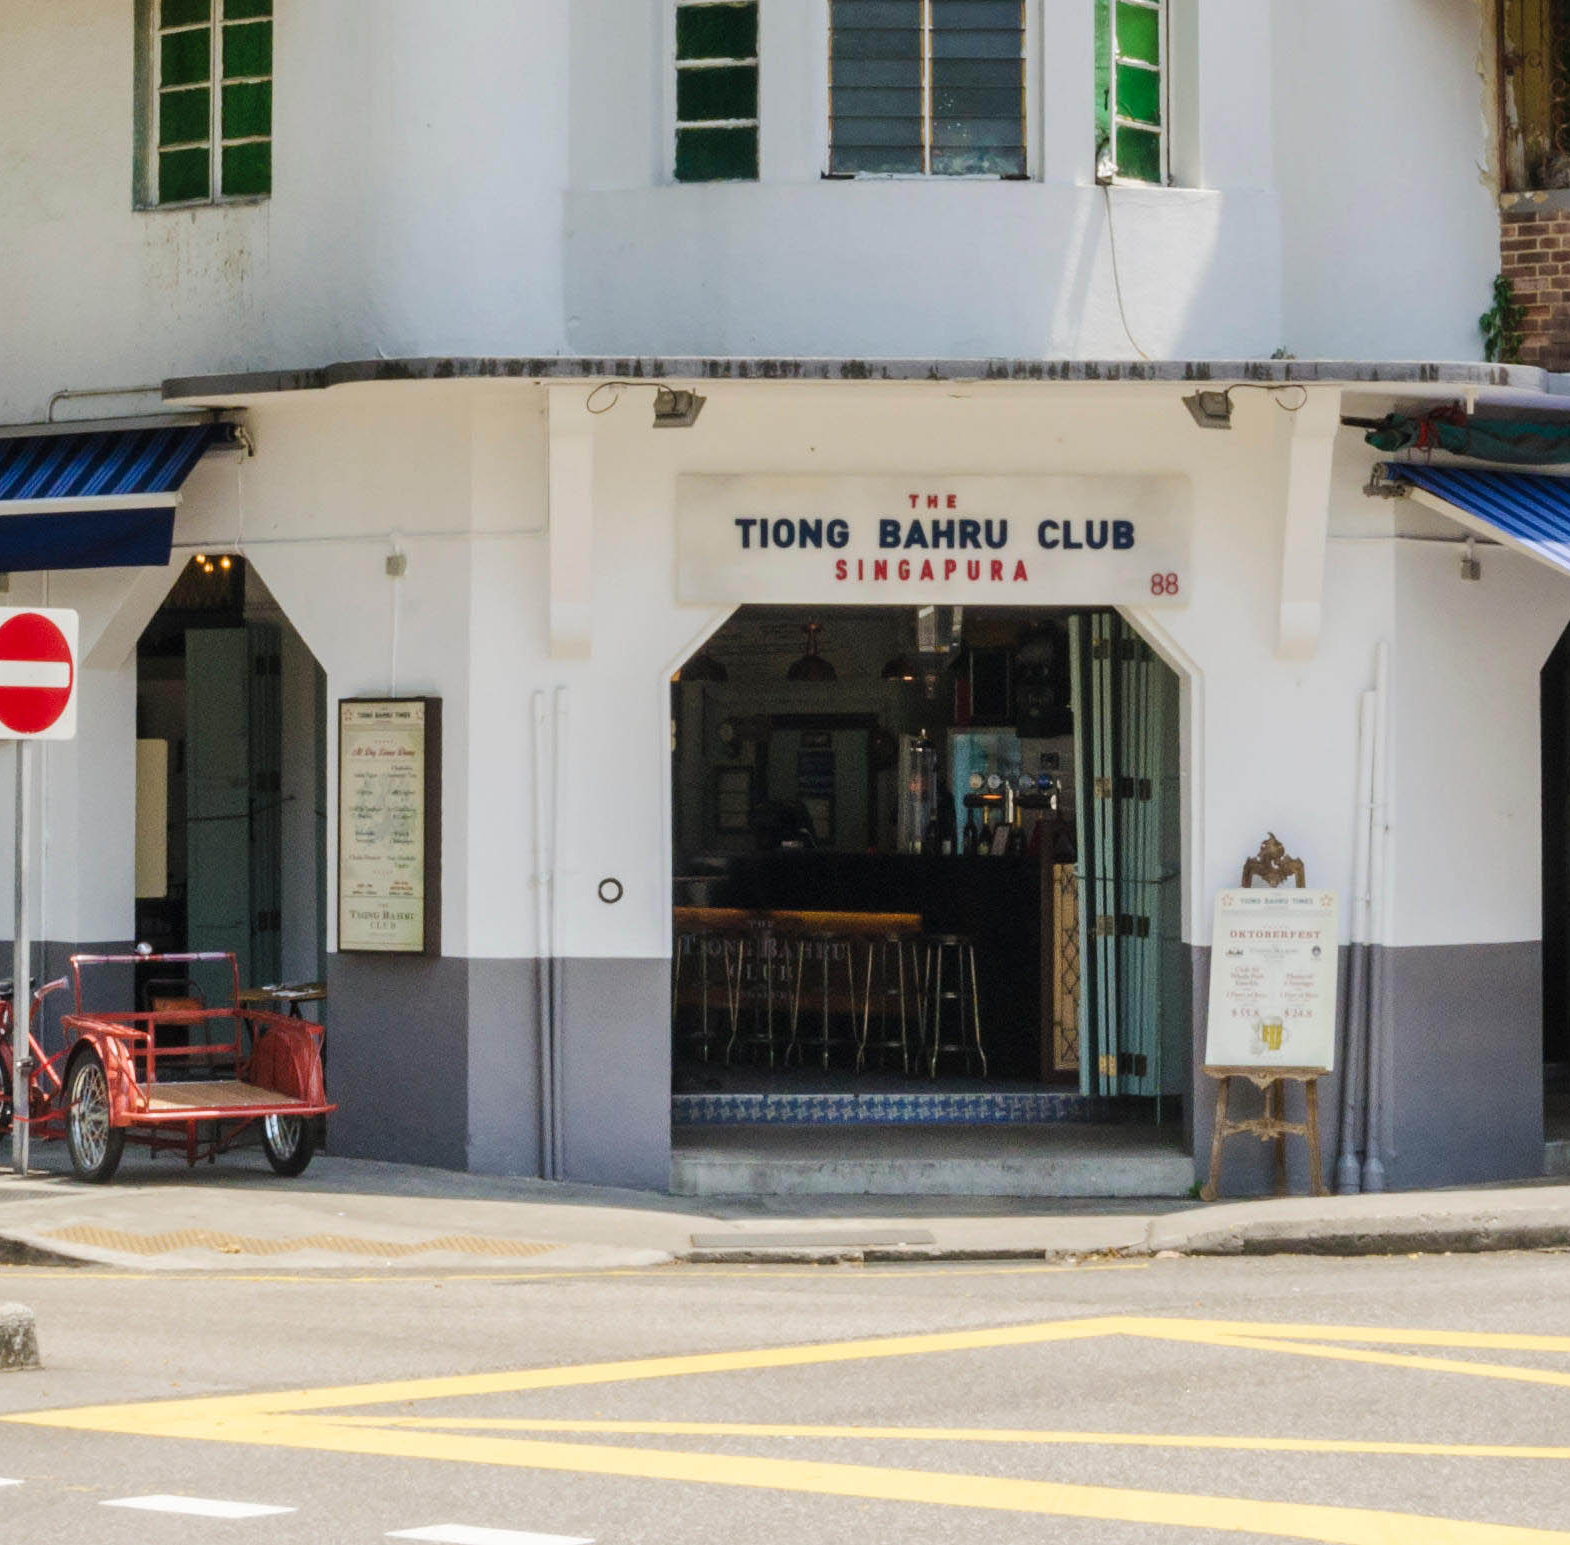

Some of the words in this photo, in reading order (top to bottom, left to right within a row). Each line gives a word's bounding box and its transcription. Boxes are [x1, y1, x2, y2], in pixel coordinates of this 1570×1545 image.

[908, 494, 958, 509] THE
[735, 518, 850, 550] TIONG
[879, 519, 1008, 550] BAHRU
[1037, 520, 1136, 550] CLUB
[835, 559, 1029, 582] SINGAPURA
[1150, 572, 1179, 596] 88
[1230, 931, 1321, 939] OKTOBERFEST
